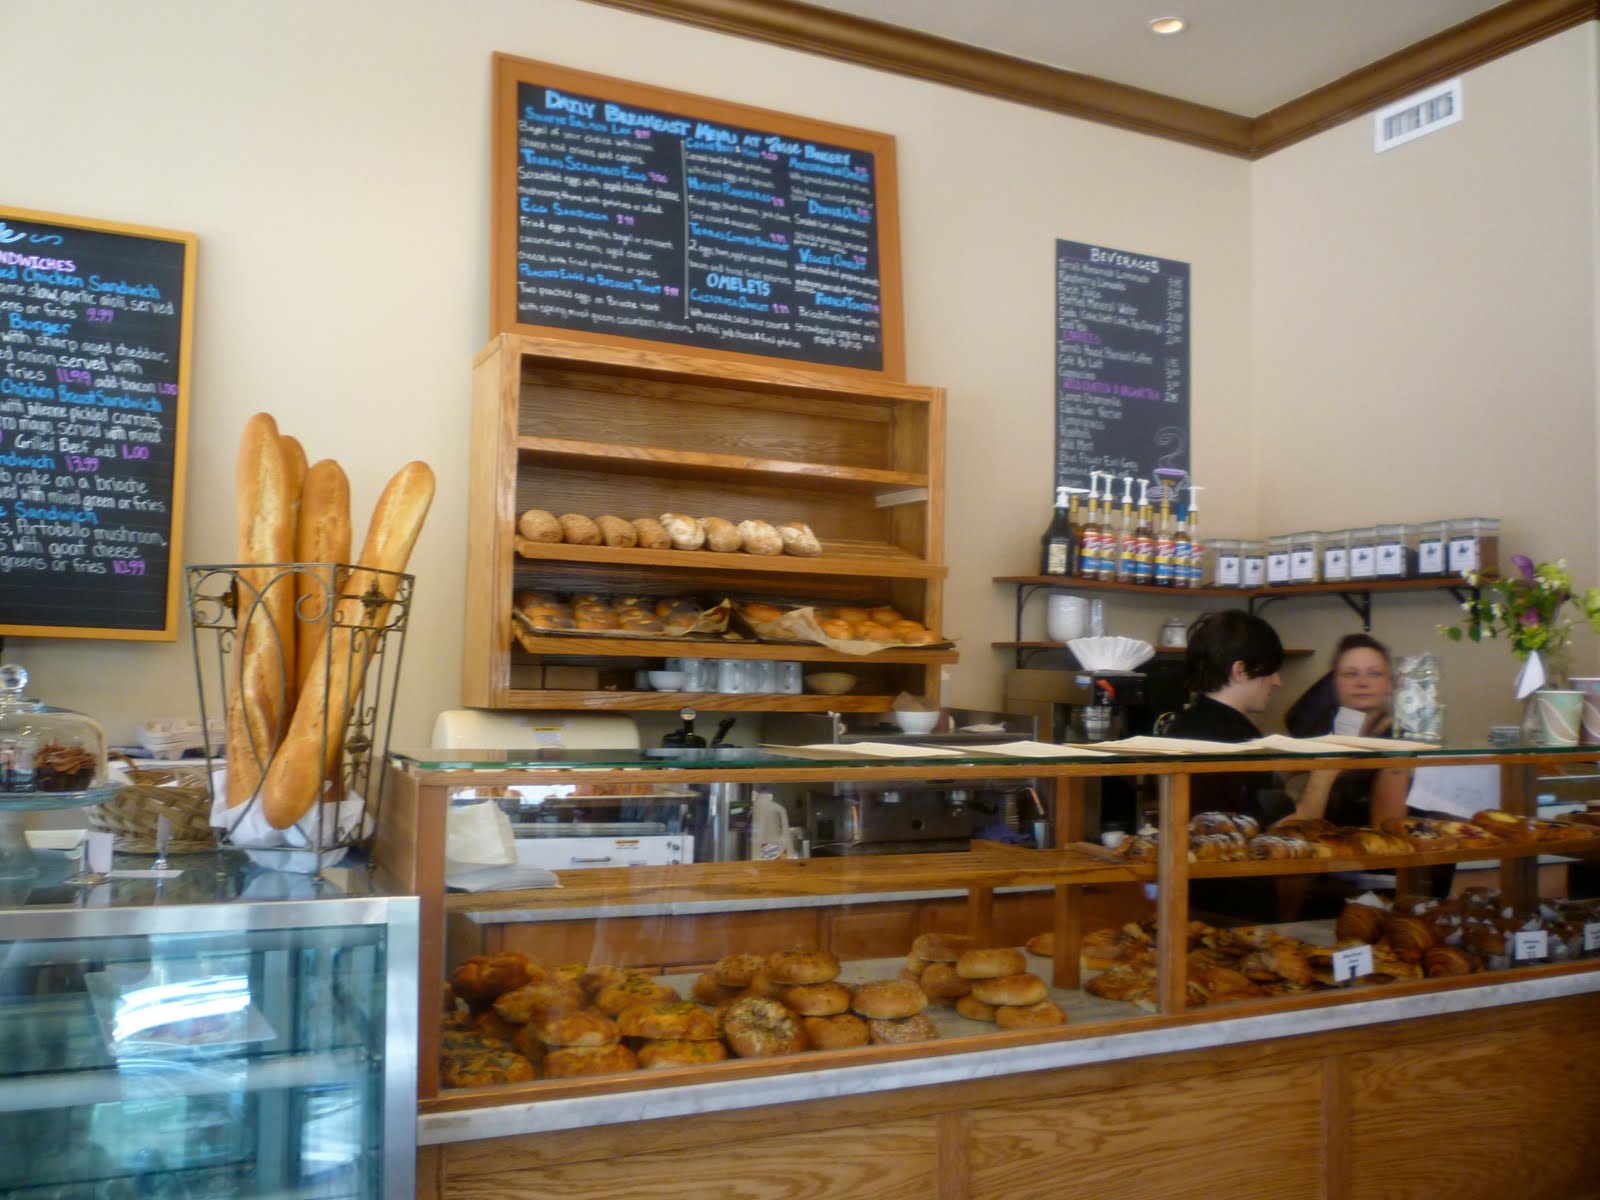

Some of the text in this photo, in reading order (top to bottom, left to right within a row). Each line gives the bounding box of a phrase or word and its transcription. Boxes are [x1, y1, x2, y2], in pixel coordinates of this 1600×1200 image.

[545, 89, 596, 119] DAILY
[604, 103, 691, 136] BREAKFAST
[742, 134, 762, 148] AT
[23, 267, 161, 299] Chicken Sandwich
[706, 272, 772, 297] OMELETS
[43, 302, 78, 319] fries
[130, 301, 174, 315] served
[9, 312, 72, 336] Burger
[35, 335, 79, 353] sharp
[5, 362, 48, 381] fries
[58, 355, 109, 372] served
[0, 377, 56, 400] Chicken
[95, 389, 163, 413] Sandwich
[58, 436, 90, 454] Beef
[15, 468, 51, 485] cake
[95, 474, 148, 494] brioche
[14, 501, 99, 526] Sandwich
[132, 495, 166, 513] fries
[16, 517, 91, 538] Portobello
[48, 539, 88, 559] goat
[91, 540, 141, 559] cheese
[0, 555, 48, 573] greens
[72, 557, 107, 575] fries
